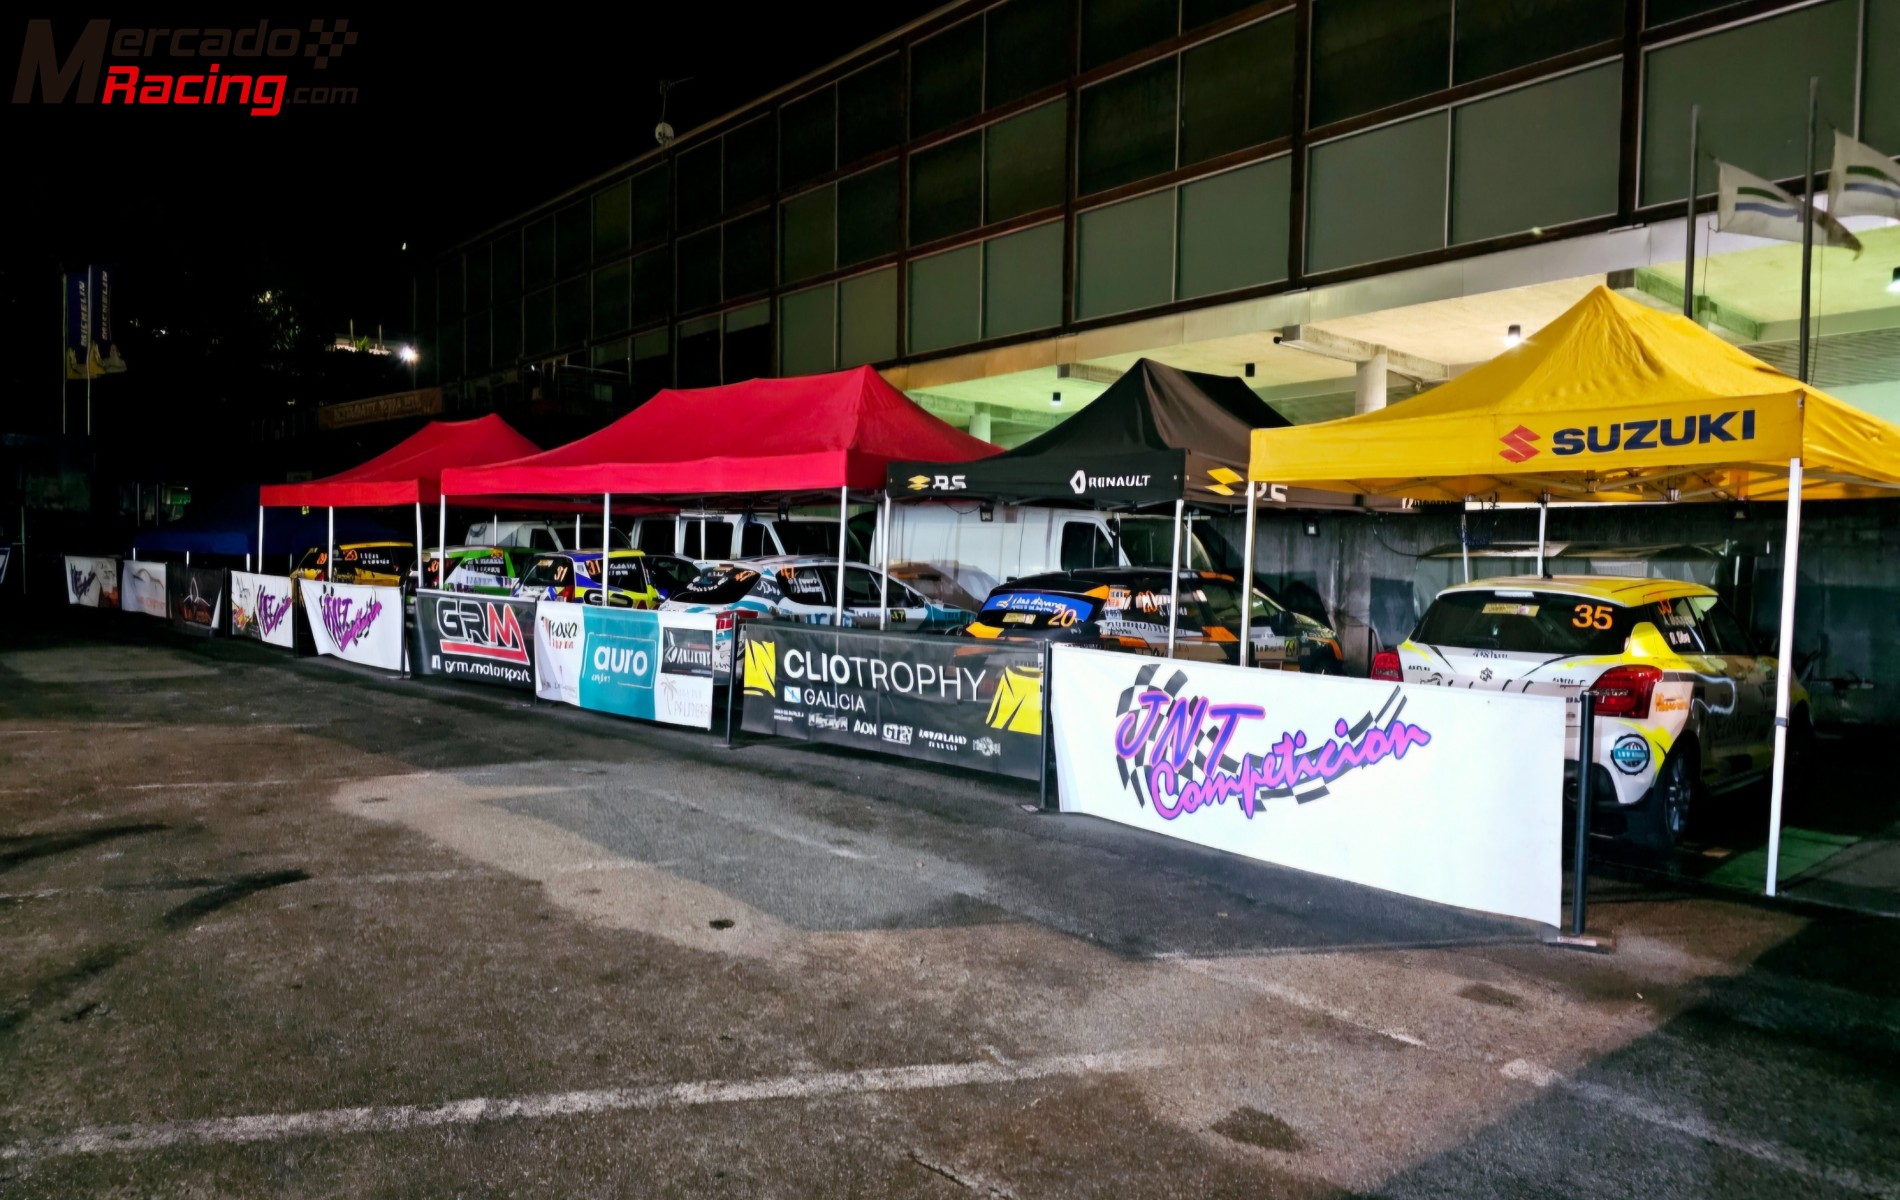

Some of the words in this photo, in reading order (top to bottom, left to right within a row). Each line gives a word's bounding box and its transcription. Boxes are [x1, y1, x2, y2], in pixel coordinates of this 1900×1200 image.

[1551, 409, 1756, 456] SUZUKI
[932, 474, 968, 490] RS
[1088, 474, 1151, 488] RENAULT
[1047, 608, 1078, 628] 20
[1572, 604, 1613, 630] 35
[436, 597, 530, 664] GRM
[593, 645, 649, 677] auro
[803, 688, 867, 713] GALICIA
[1114, 689, 1266, 779] JNT
